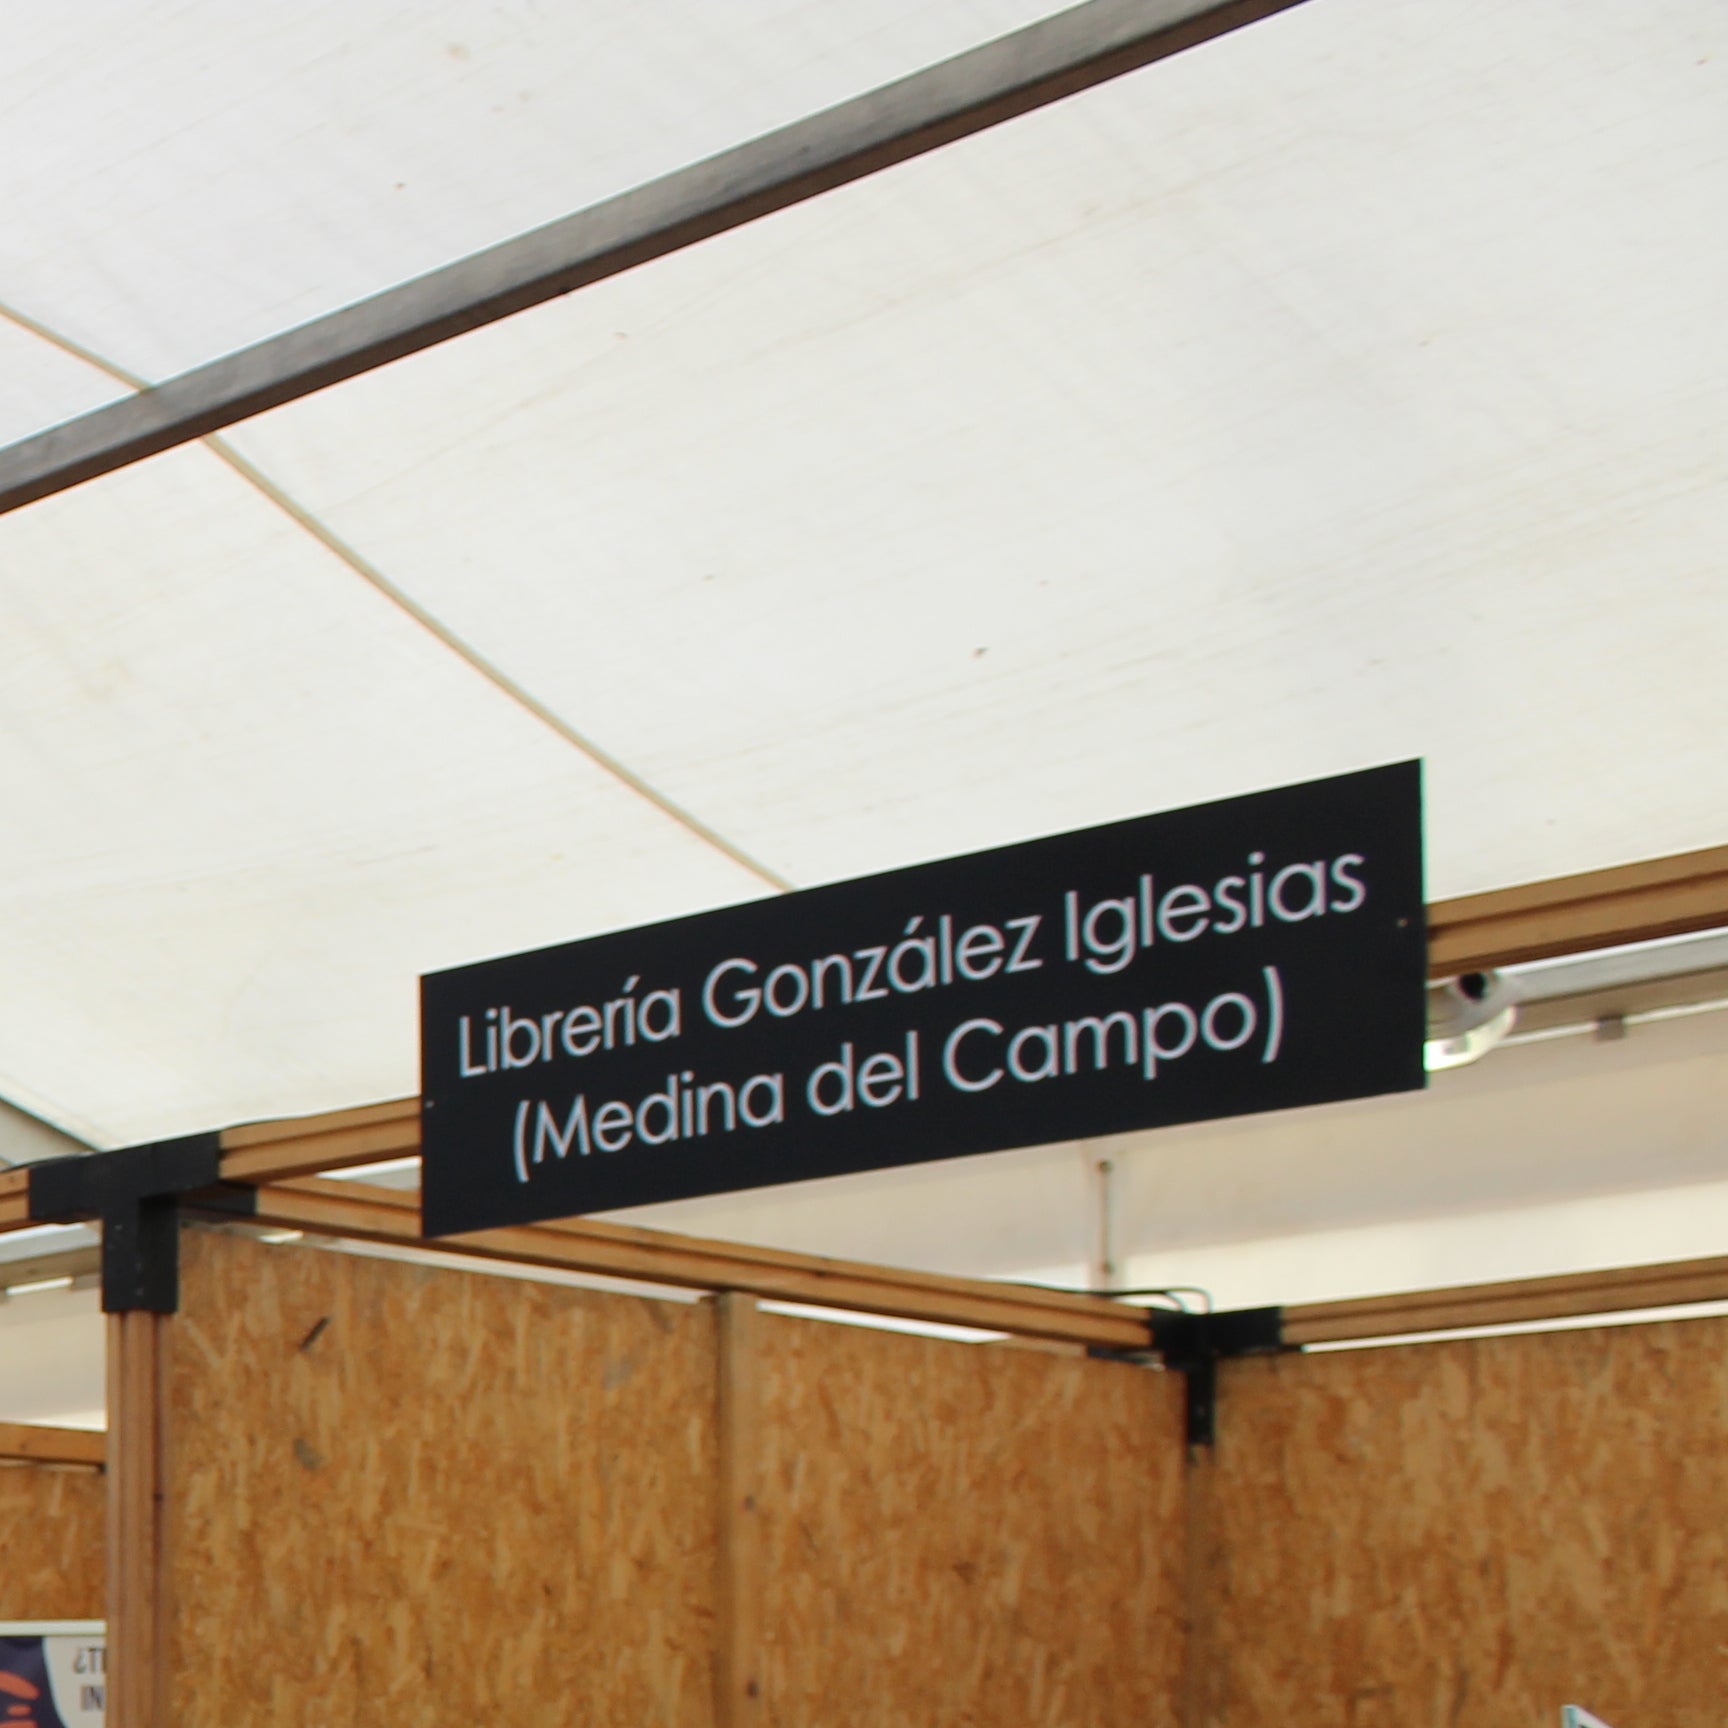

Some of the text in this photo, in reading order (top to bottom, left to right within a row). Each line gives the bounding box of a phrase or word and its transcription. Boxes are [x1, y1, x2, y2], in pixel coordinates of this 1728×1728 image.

[458, 850, 1367, 1079] Librería González Iglesias
[513, 965, 1284, 1184] (Medina del Campo)
